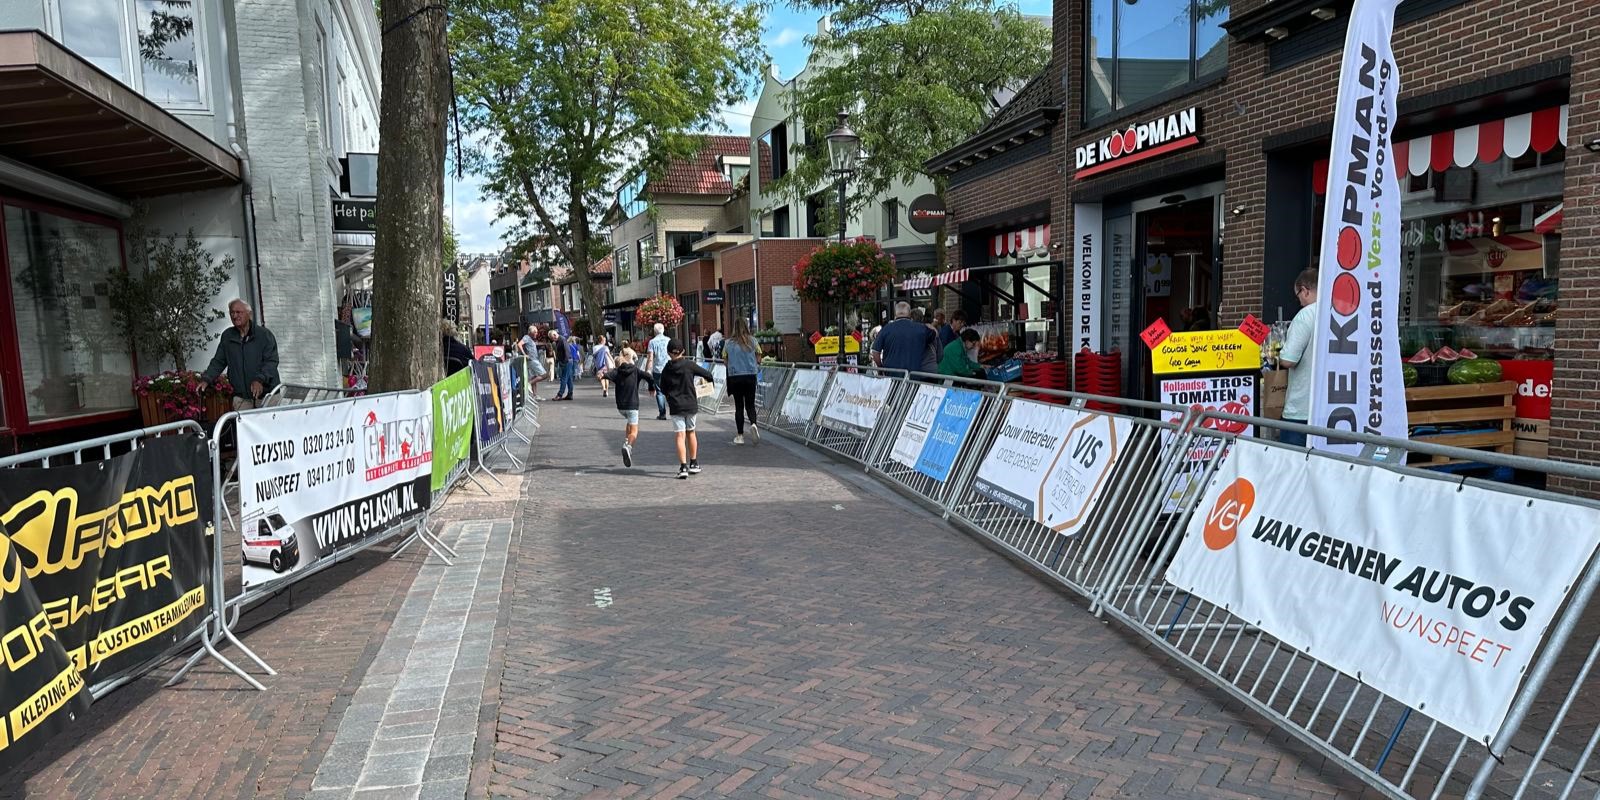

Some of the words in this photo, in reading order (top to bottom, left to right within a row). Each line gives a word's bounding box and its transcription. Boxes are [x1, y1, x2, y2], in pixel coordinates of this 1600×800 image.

[1075, 142, 1096, 169] DE
[1099, 107, 1196, 162] KOOPMAN
[334, 204, 357, 217] Het
[360, 205, 376, 222] pa
[913, 209, 945, 217] KOOPMAN
[1328, 42, 1376, 354] KOOPMAN
[1367, 211, 1382, 271] Vers
[1082, 234, 1092, 290] WELKOM
[1081, 293, 1091, 311] BIJ
[1081, 315, 1091, 334] DE
[1163, 380, 1207, 392] Hollandse
[1210, 376, 1253, 389] TROS
[1169, 389, 1237, 405] TOMATEN
[1327, 371, 1357, 444] DE
[303, 434, 323, 455] 0320
[325, 431, 334, 450] 23
[335, 430, 344, 447] 24
[1000, 419, 1021, 440] Jouw
[996, 447, 1014, 466] onze
[1012, 450, 1042, 473] passie!
[1072, 429, 1103, 469] VIS
[256, 473, 300, 503] NUNSPEET
[307, 467, 324, 488] 0341
[326, 463, 335, 482] 21
[337, 461, 344, 479] 71
[1051, 485, 1059, 497] &
[1054, 467, 1086, 499] INTERIEUR
[1251, 514, 1302, 551] VAN
[1299, 531, 1402, 585] GEENEN
[1394, 565, 1536, 632] AUTO'S
[97, 620, 153, 655] CUSTOM
[154, 591, 201, 629] TEAMKLEDING
[1380, 600, 1512, 669] NUNSPEET
[20, 681, 67, 728] KLEDING
